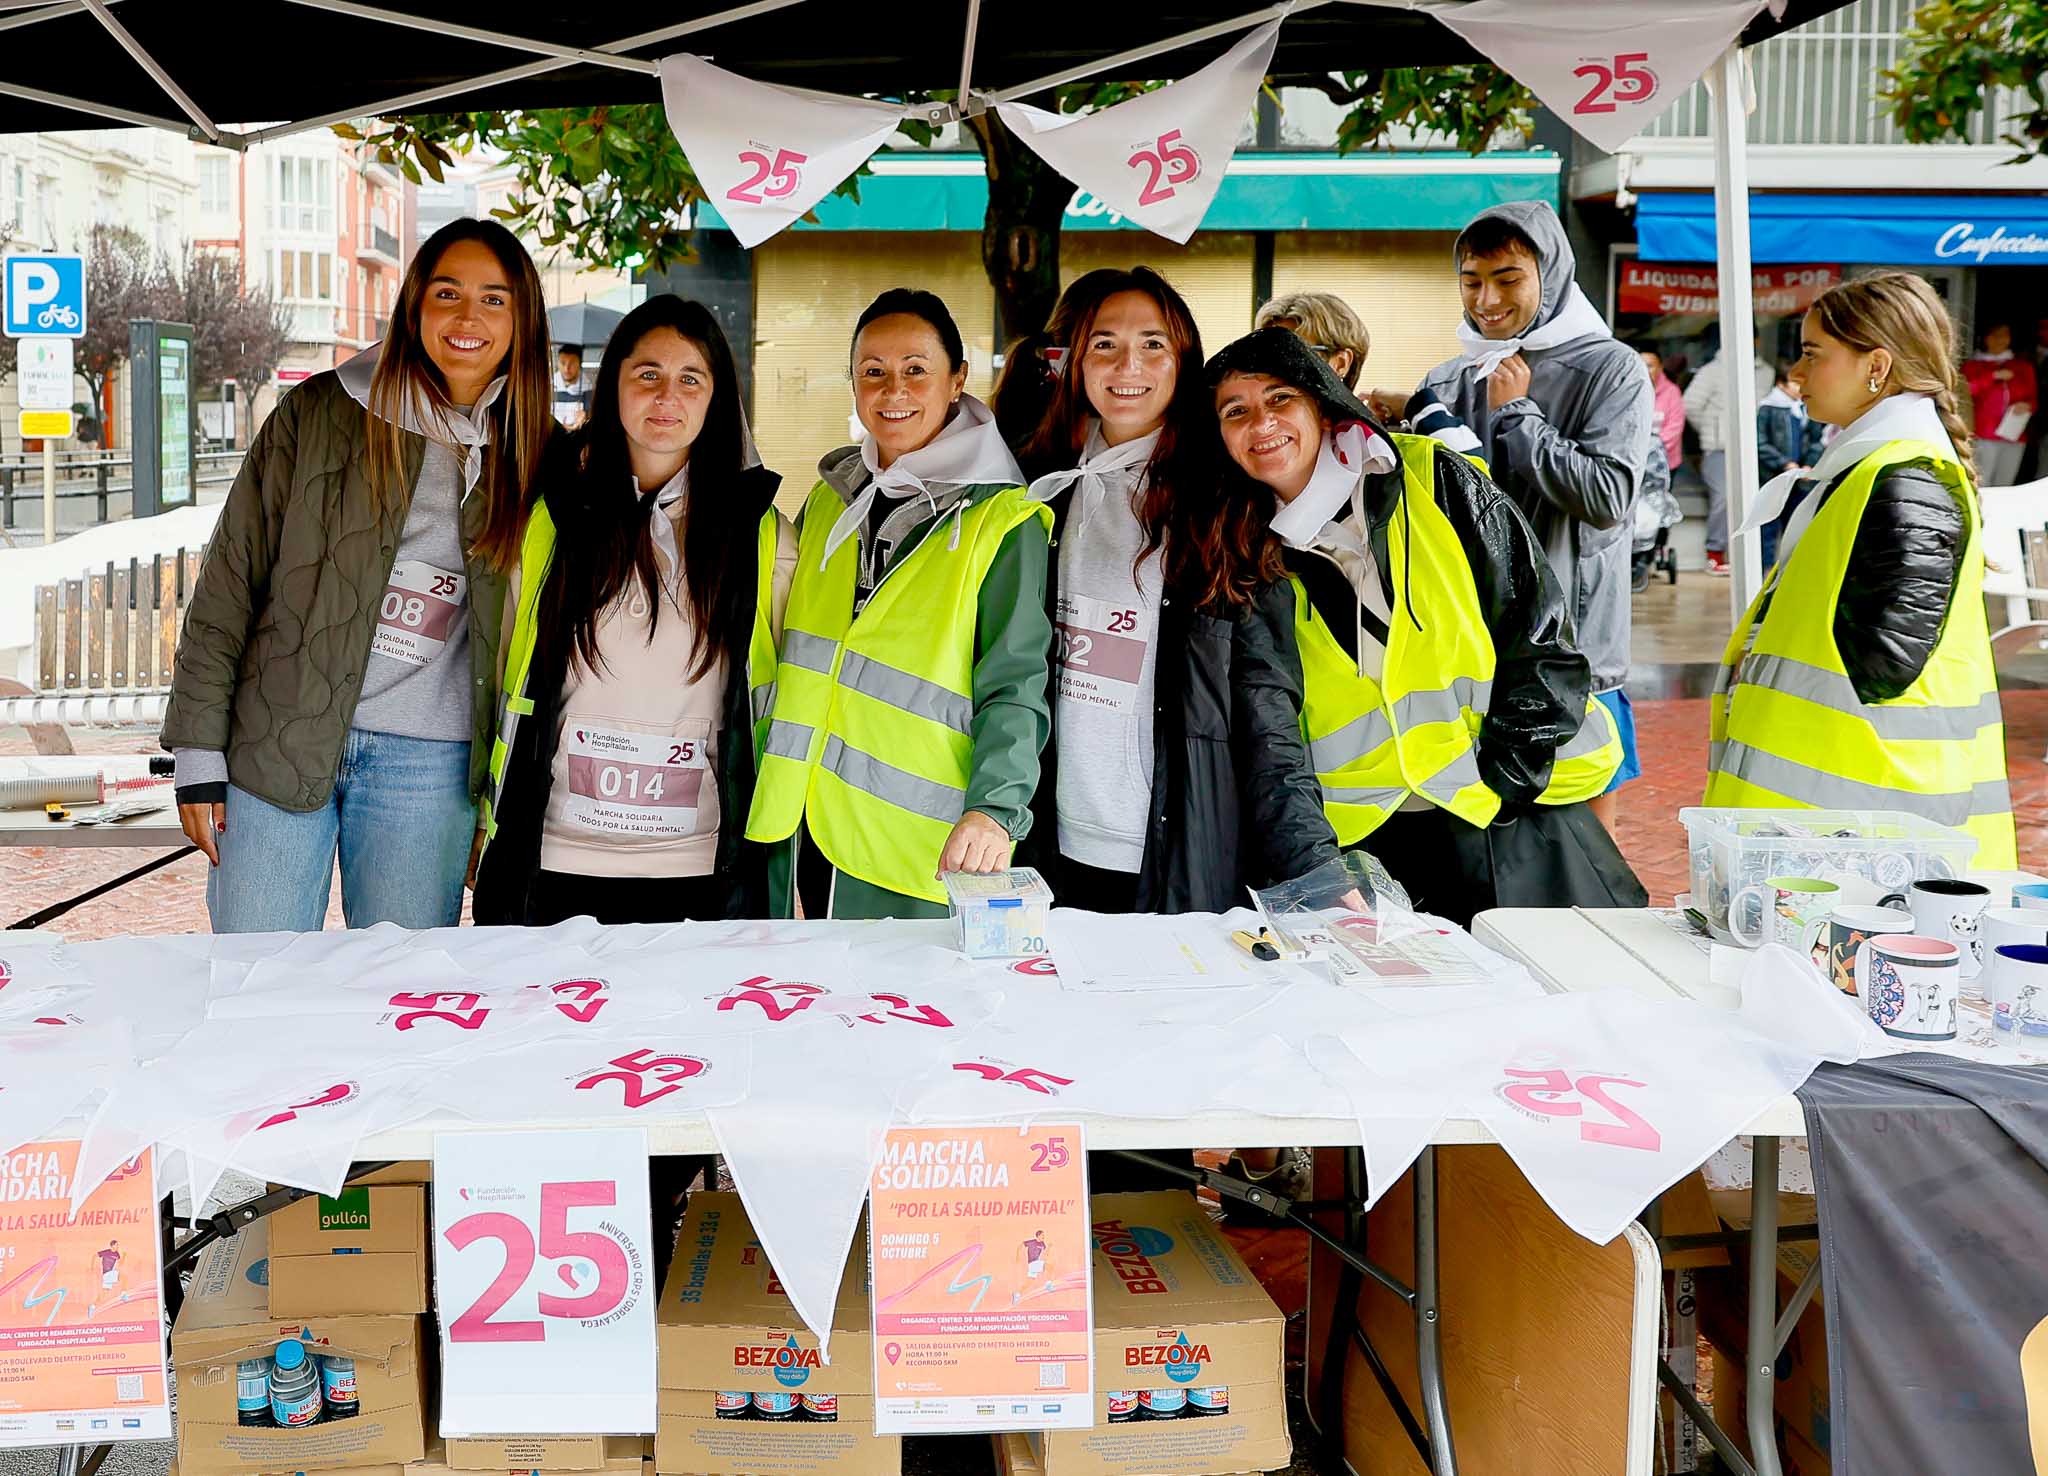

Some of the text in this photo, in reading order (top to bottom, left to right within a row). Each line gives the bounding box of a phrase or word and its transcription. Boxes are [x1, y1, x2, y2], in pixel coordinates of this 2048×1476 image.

[1573, 52, 1653, 114] 25
[727, 148, 808, 204] 25
[1127, 128, 1198, 207] 25
[1629, 268, 1831, 289] LIQUIDAN POR
[12, 261, 60, 325] P
[429, 575, 458, 597] 25
[1106, 609, 1138, 633] 25
[379, 632, 416, 649] SOLIDARIA
[382, 645, 405, 657] SALUD
[1062, 677, 1098, 691] SOLIDARIA
[1064, 690, 1088, 701] SALUD
[591, 740, 639, 753] Hospitalarias
[592, 732, 631, 745] Fundación
[666, 742, 695, 765] 25
[599, 766, 665, 801] 014
[593, 808, 663, 822] MARCHA SOLIDARIA
[602, 821, 619, 830] POR
[620, 823, 629, 831] LA
[631, 824, 654, 833] SALUD
[1022, 936, 1044, 953] 20
[575, 1048, 704, 1108] 25
[879, 1140, 986, 1166] MARCHA
[1030, 1137, 1070, 1172] 25
[0, 1151, 60, 1178] RCHA
[877, 1163, 1009, 1190] SOLIDARIA
[322, 1210, 369, 1228] gullón
[932, 1203, 949, 1218] LA
[953, 1202, 1004, 1217] SALUD
[7, 1219, 25, 1231] LA
[880, 1232, 941, 1246] DOMINGO 5
[443, 1180, 629, 1343] 25
[881, 1247, 928, 1260] OCTUBRE
[1093, 1218, 1168, 1295] BEZOYA
[580, 1220, 643, 1328] ANIVERSARIO CRPS TORRELAVEGA
[734, 1346, 821, 1368] BEZOYA
[1125, 1344, 1212, 1366] BEZOYA
